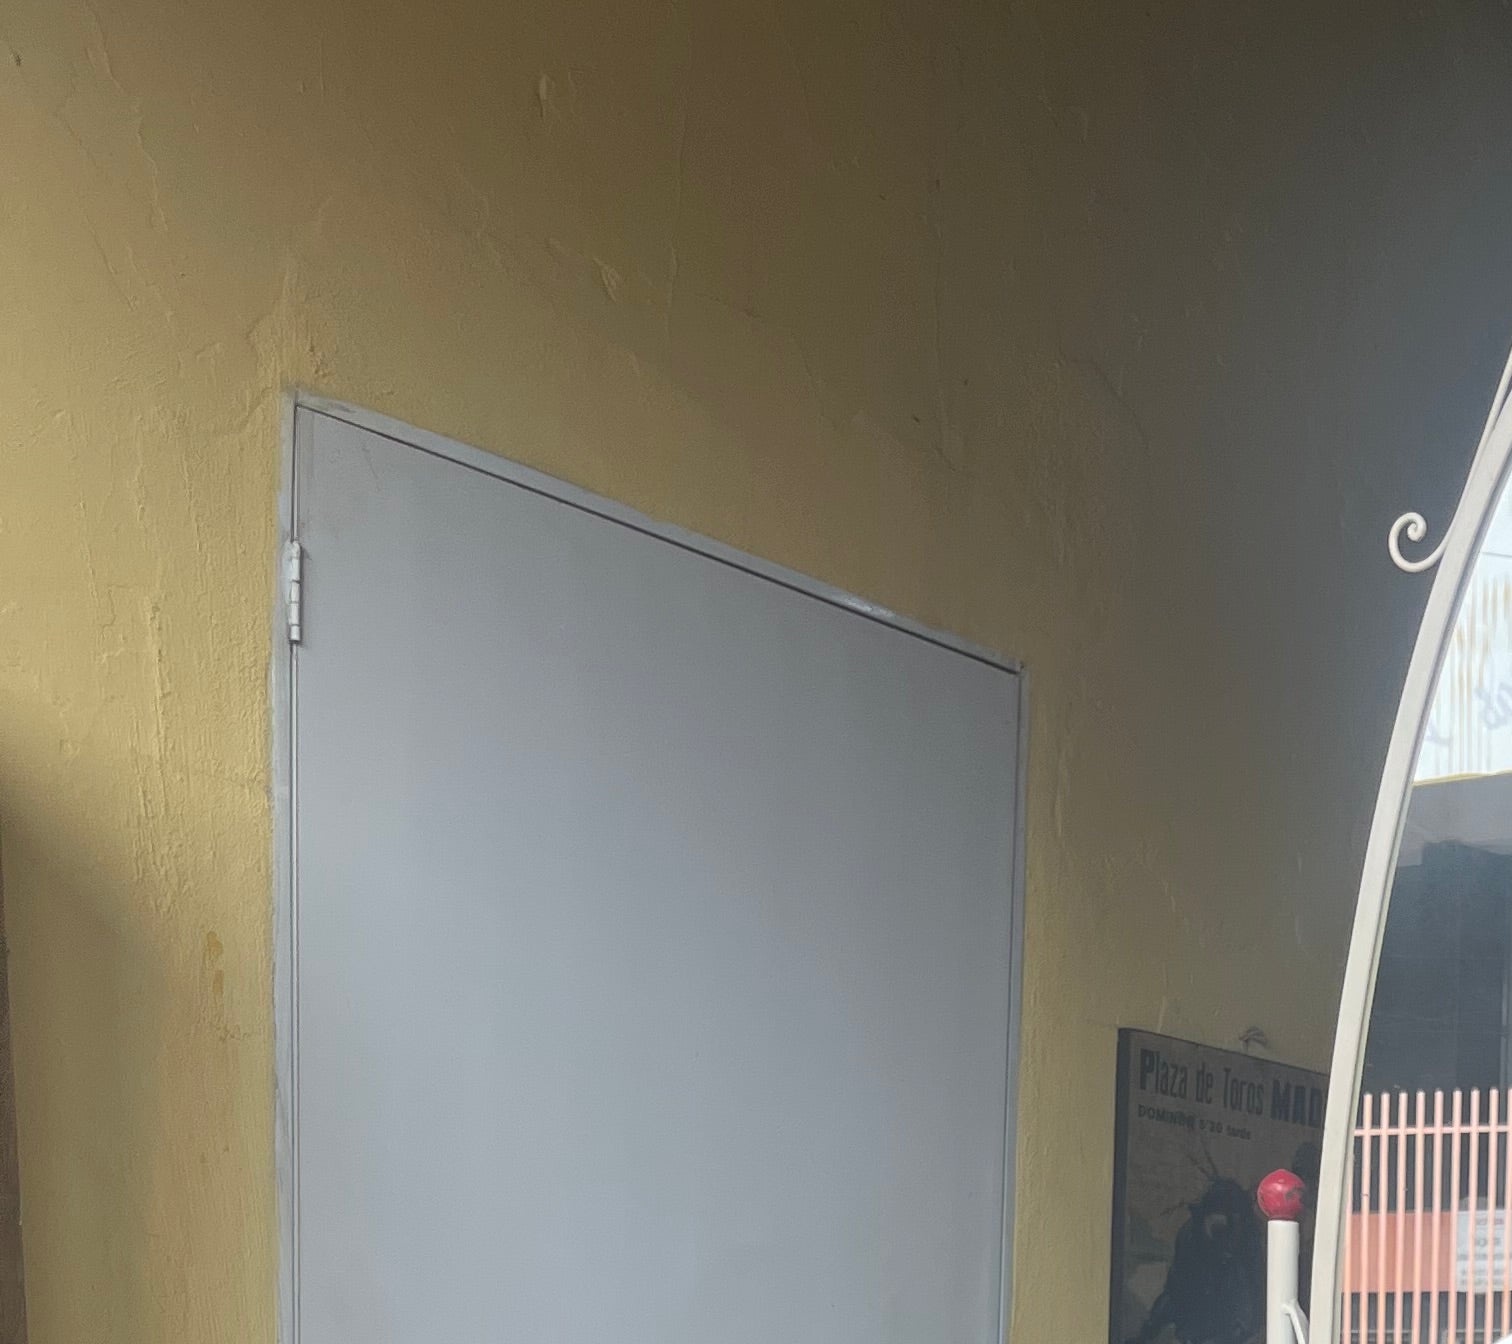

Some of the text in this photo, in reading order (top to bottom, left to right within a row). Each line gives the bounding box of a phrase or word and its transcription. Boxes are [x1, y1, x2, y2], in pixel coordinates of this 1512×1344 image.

[1139, 1048, 1323, 1129] Plaza de Toros MAD
